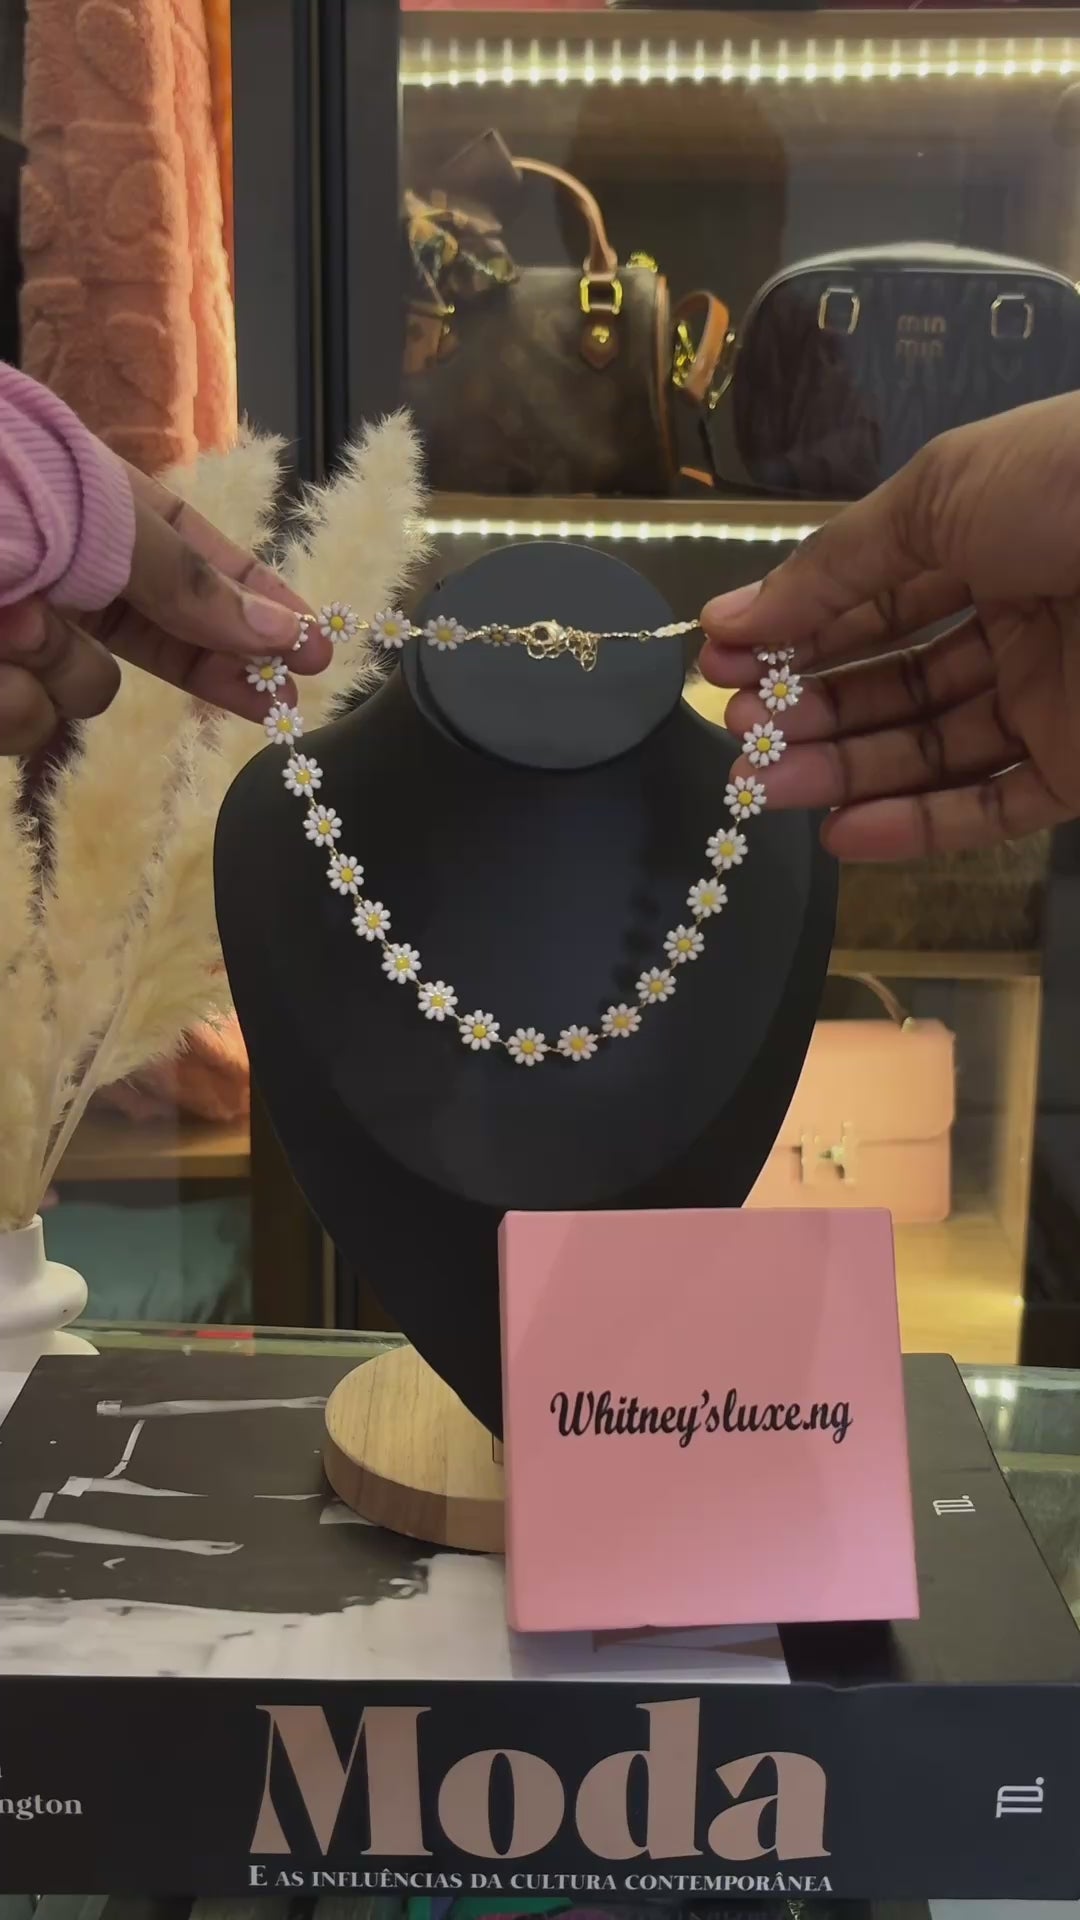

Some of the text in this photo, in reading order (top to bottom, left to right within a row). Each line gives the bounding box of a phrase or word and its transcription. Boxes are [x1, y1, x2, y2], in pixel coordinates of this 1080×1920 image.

[549, 1388, 853, 1449] Whitney'sluxe.ng
[249, 1696, 832, 1861] Moda
[248, 1864, 833, 1892] E AS INFLUÊNCIAS DA CULTURA CONTEMPORÂNEA
